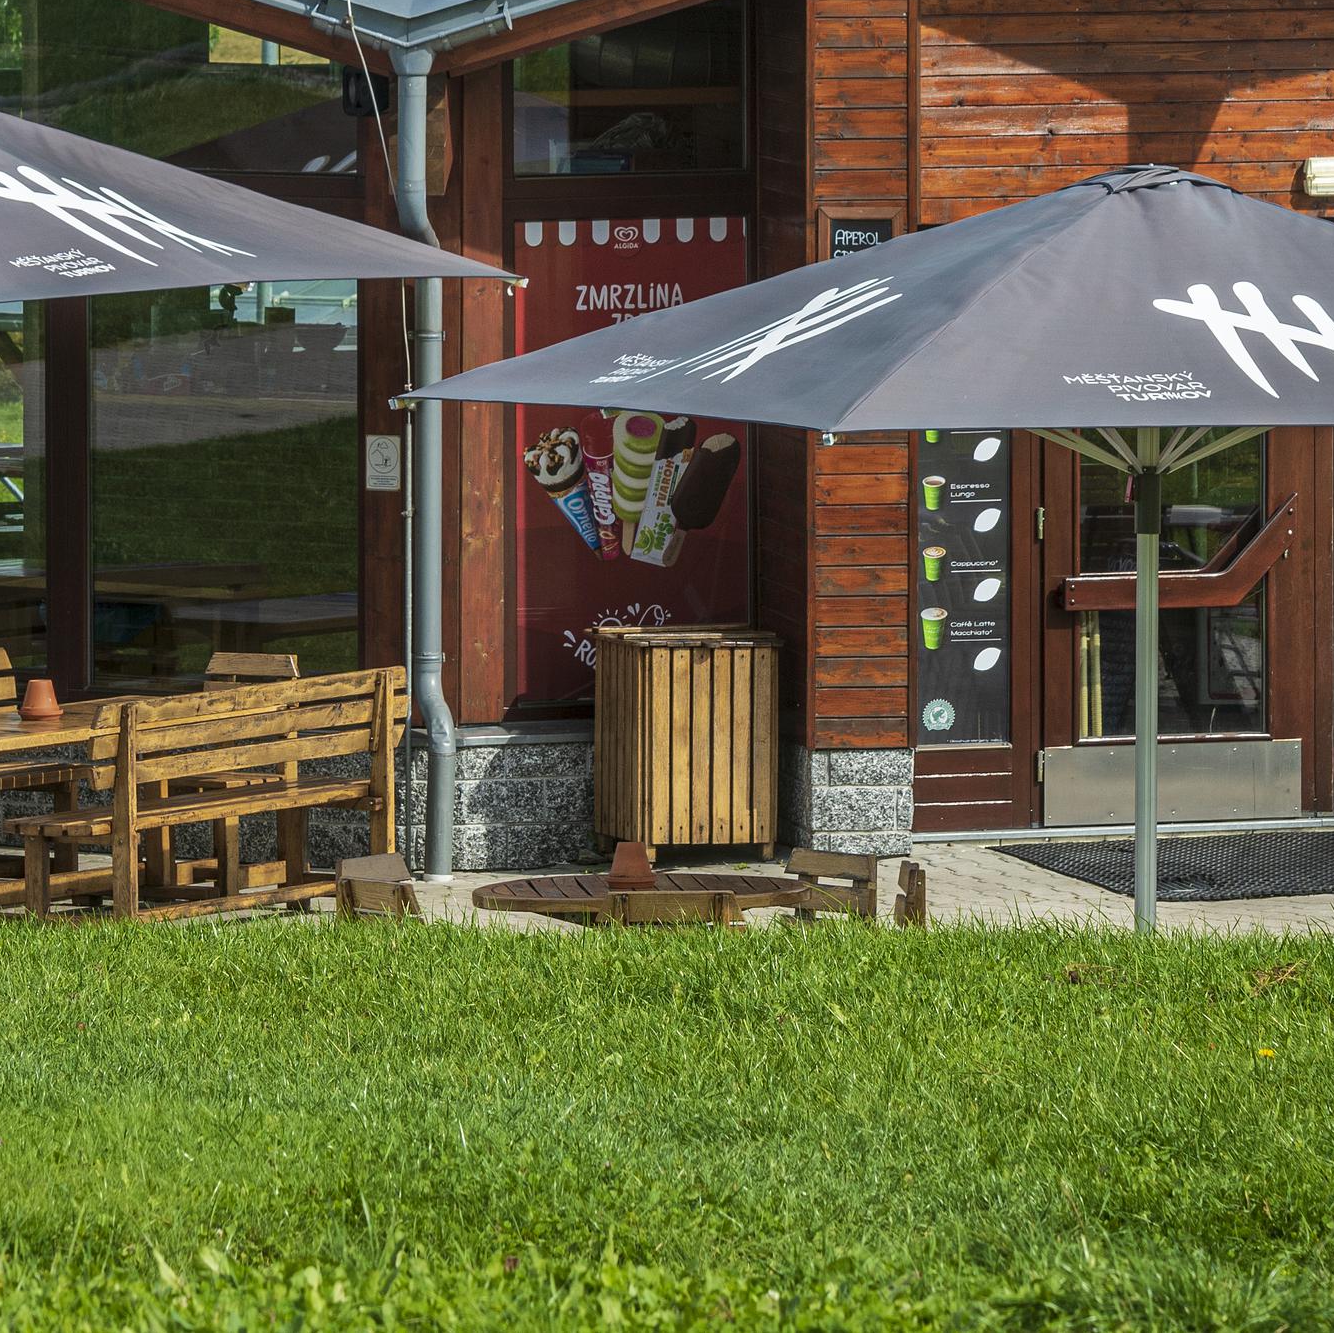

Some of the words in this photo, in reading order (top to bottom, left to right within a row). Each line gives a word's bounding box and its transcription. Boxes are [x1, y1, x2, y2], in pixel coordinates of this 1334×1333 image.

[835, 229, 881, 245] APEROL
[1107, 381, 1207, 394] PIVOVAR
[950, 483, 990, 491] Espresso
[950, 491, 976, 499] Lungo
